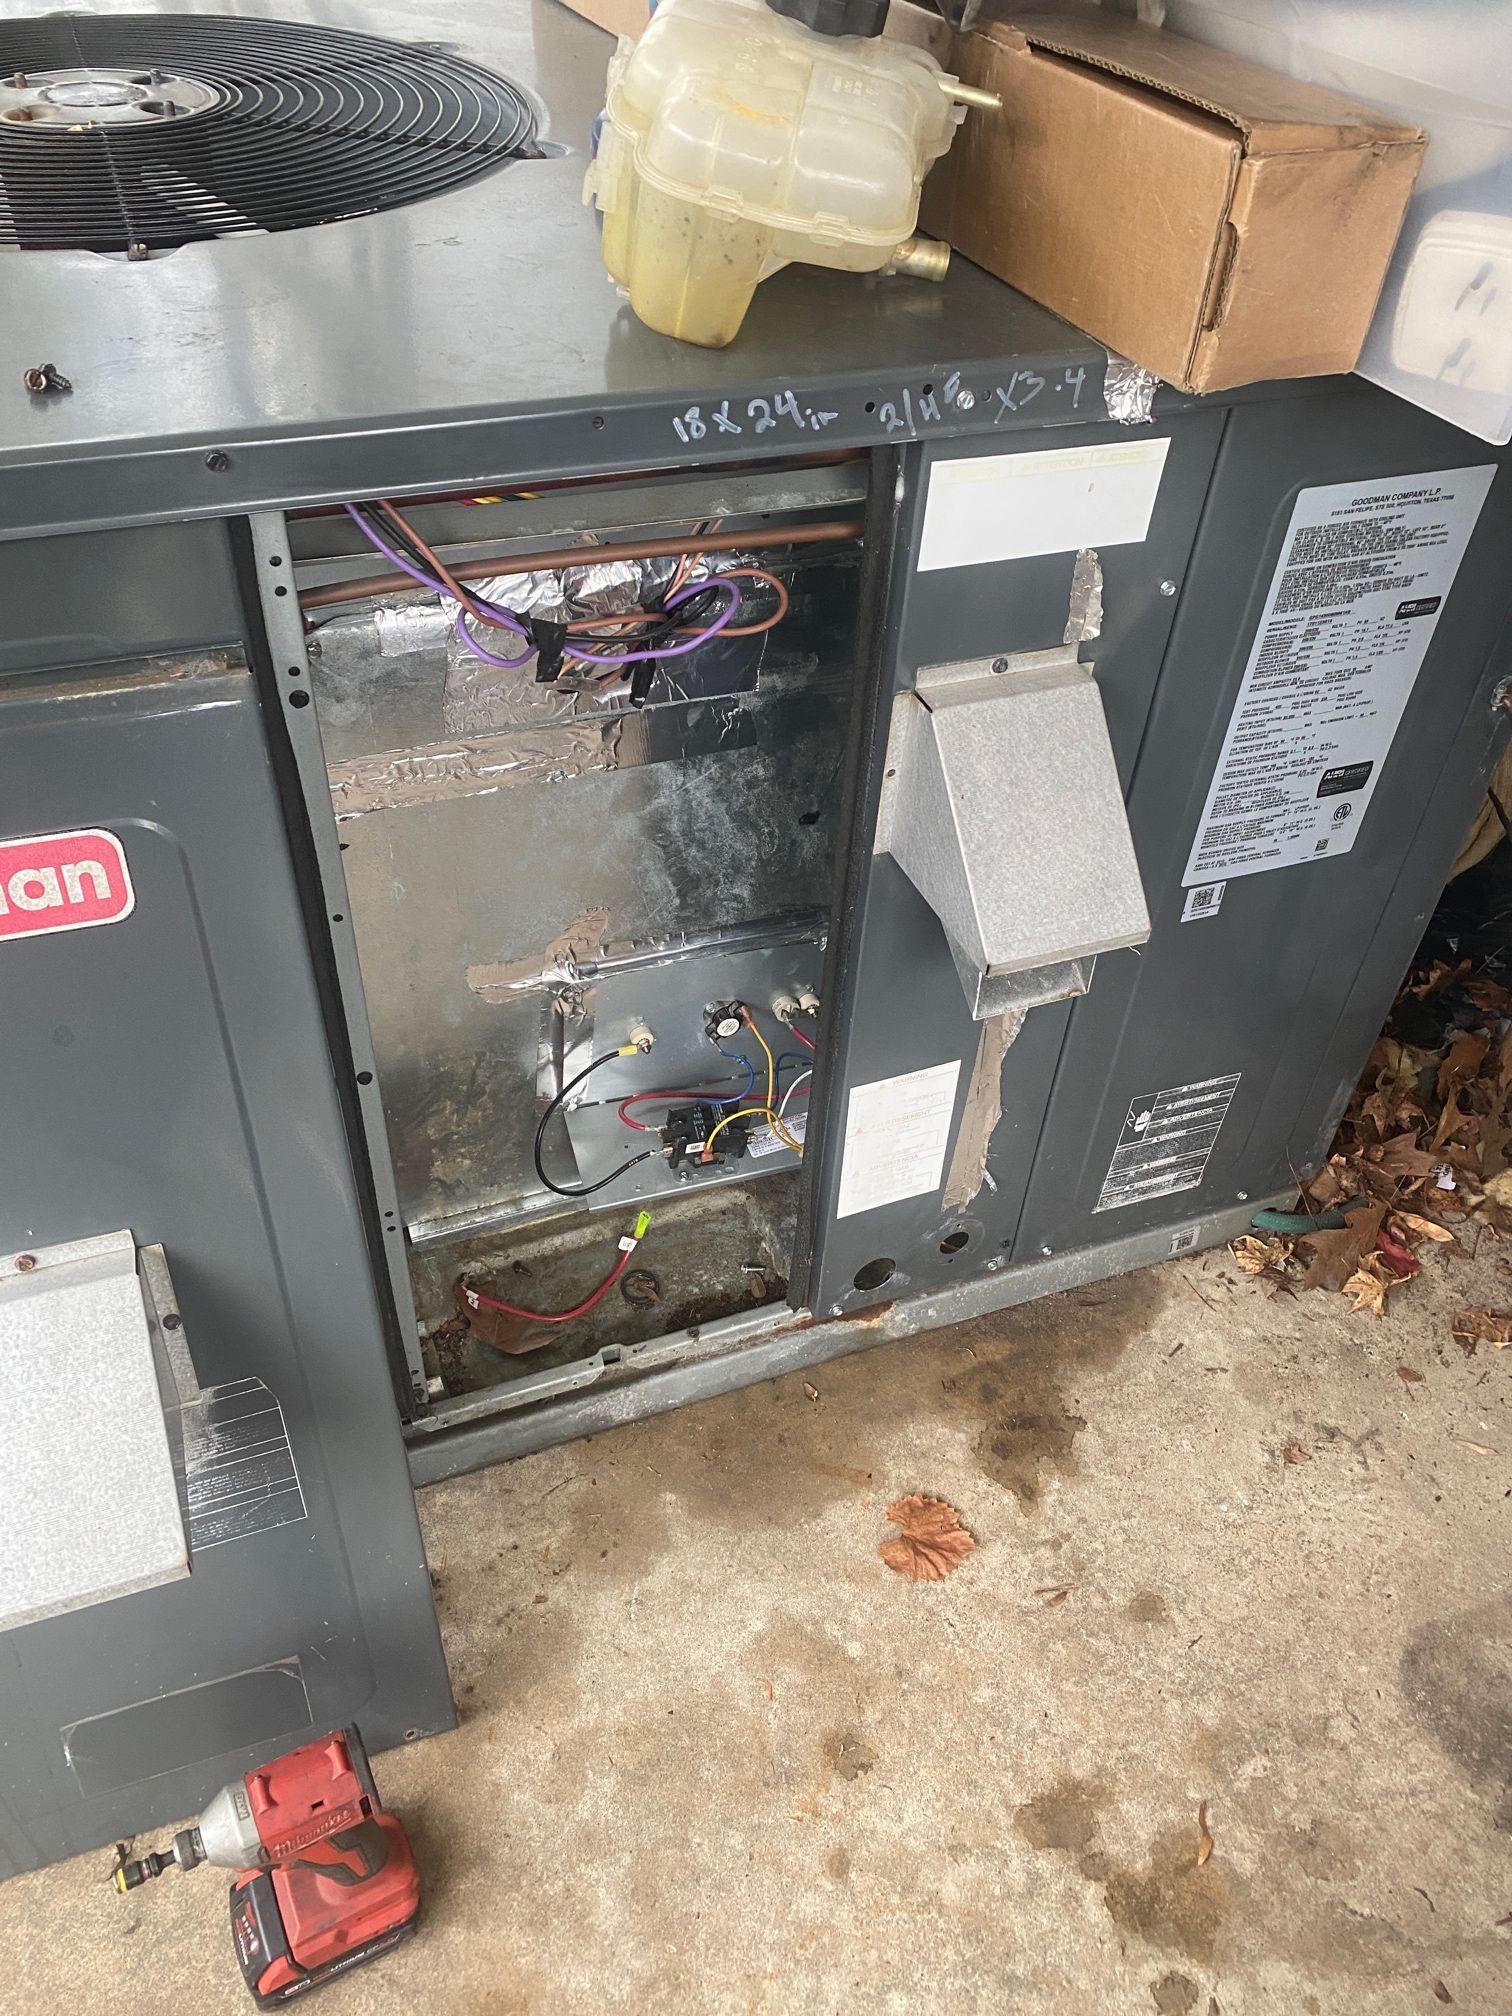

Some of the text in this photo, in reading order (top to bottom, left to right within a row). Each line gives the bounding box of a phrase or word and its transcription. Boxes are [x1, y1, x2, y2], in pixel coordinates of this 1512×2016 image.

[672, 406, 707, 443] 18
[1351, 494, 1390, 507] GOODMAN
[1391, 489, 1429, 501] COMPANY
